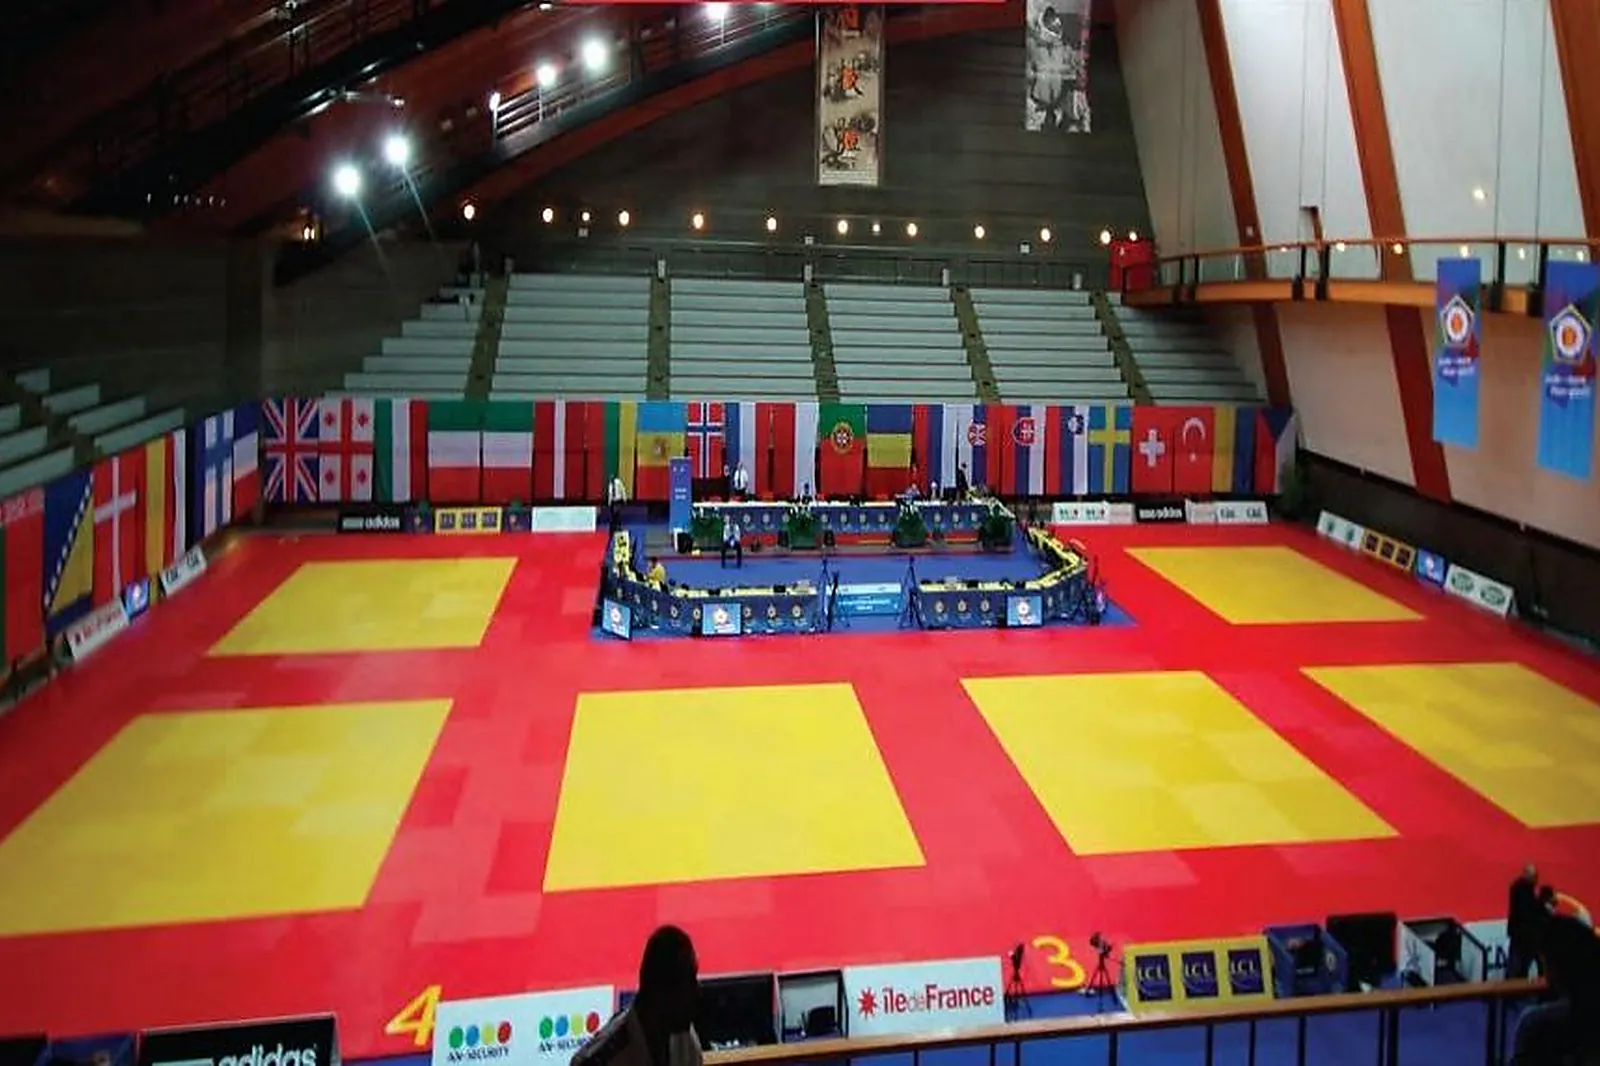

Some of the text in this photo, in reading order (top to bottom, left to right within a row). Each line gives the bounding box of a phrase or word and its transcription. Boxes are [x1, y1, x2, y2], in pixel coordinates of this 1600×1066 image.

[1032, 935, 1086, 987] 3
[1185, 961, 1210, 977] LCL
[1231, 958, 1255, 975] LCL
[1137, 965, 1163, 982] LCL
[385, 985, 442, 1046] 4
